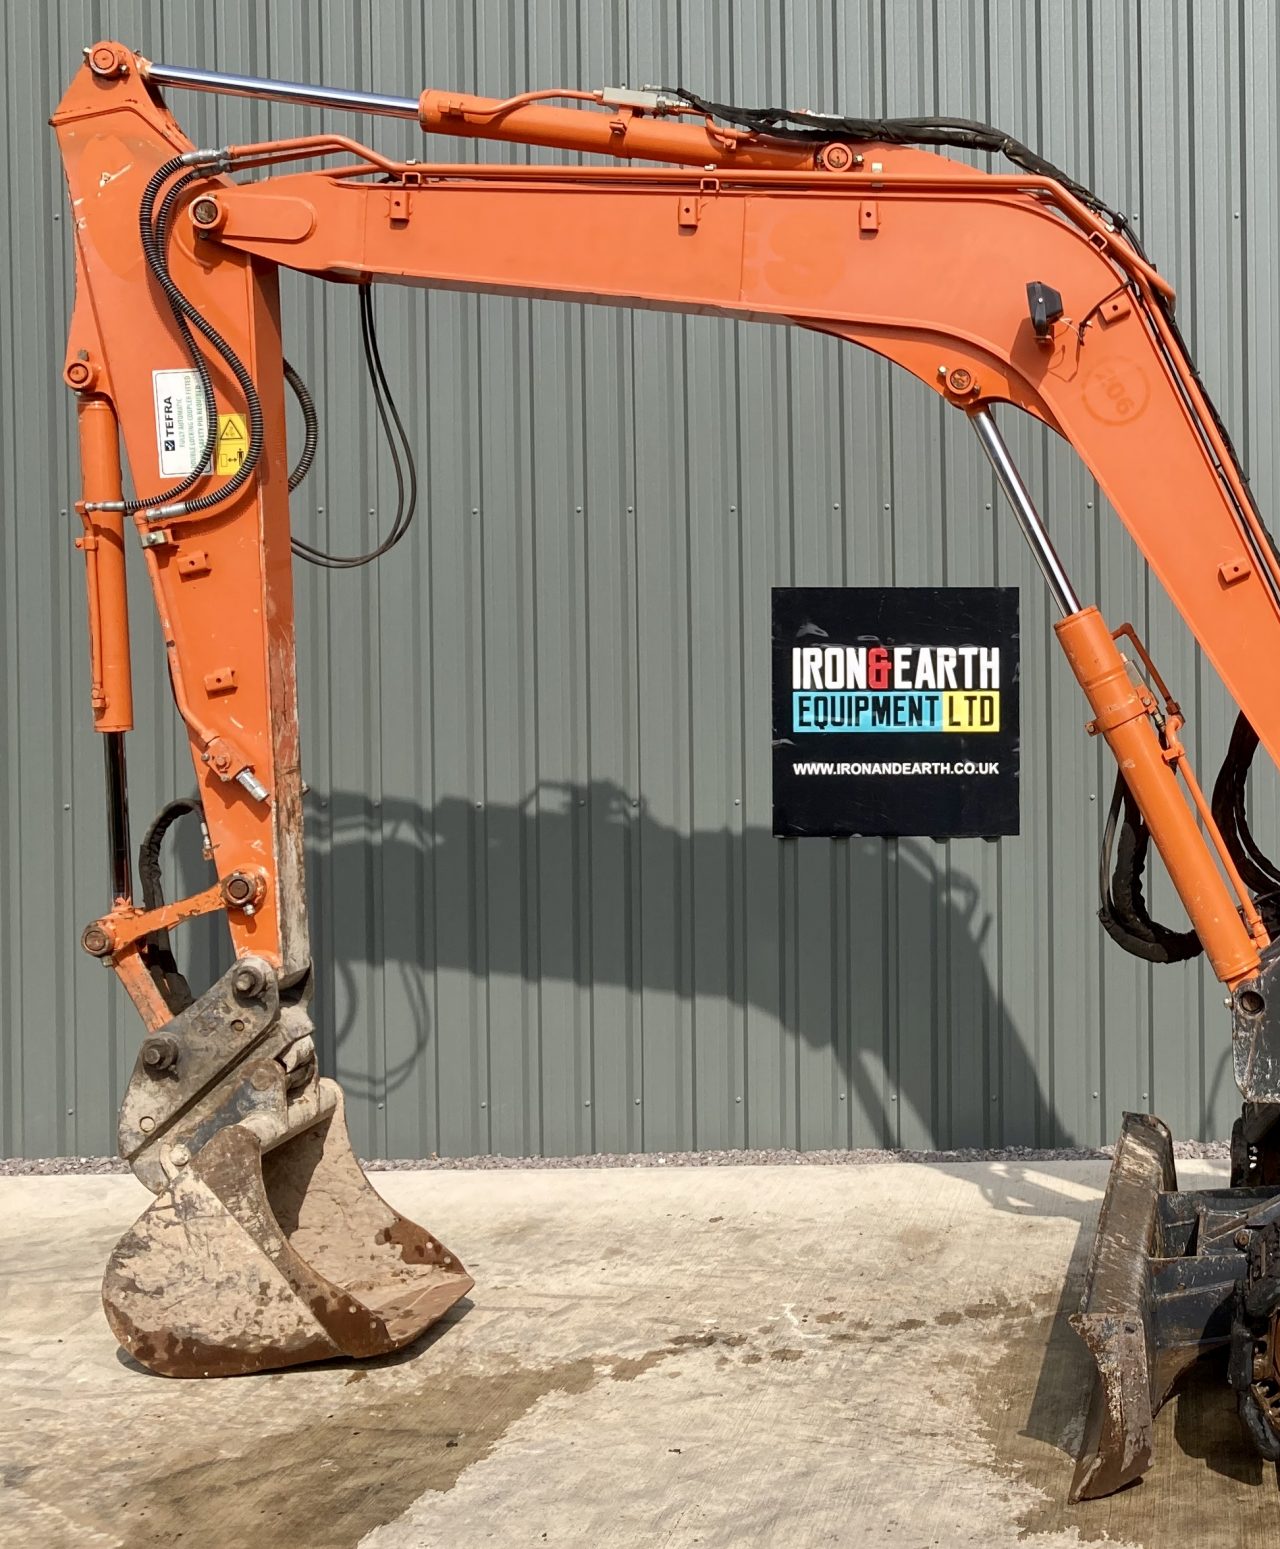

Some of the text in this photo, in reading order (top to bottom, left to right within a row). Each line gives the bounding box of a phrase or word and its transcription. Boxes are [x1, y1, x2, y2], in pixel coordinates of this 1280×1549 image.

[163, 396, 175, 437] TEFRA
[798, 695, 994, 730] EQUIPMENT LTD
[793, 762, 1000, 776] WWW.IRONANDEARTH.CO.UK
